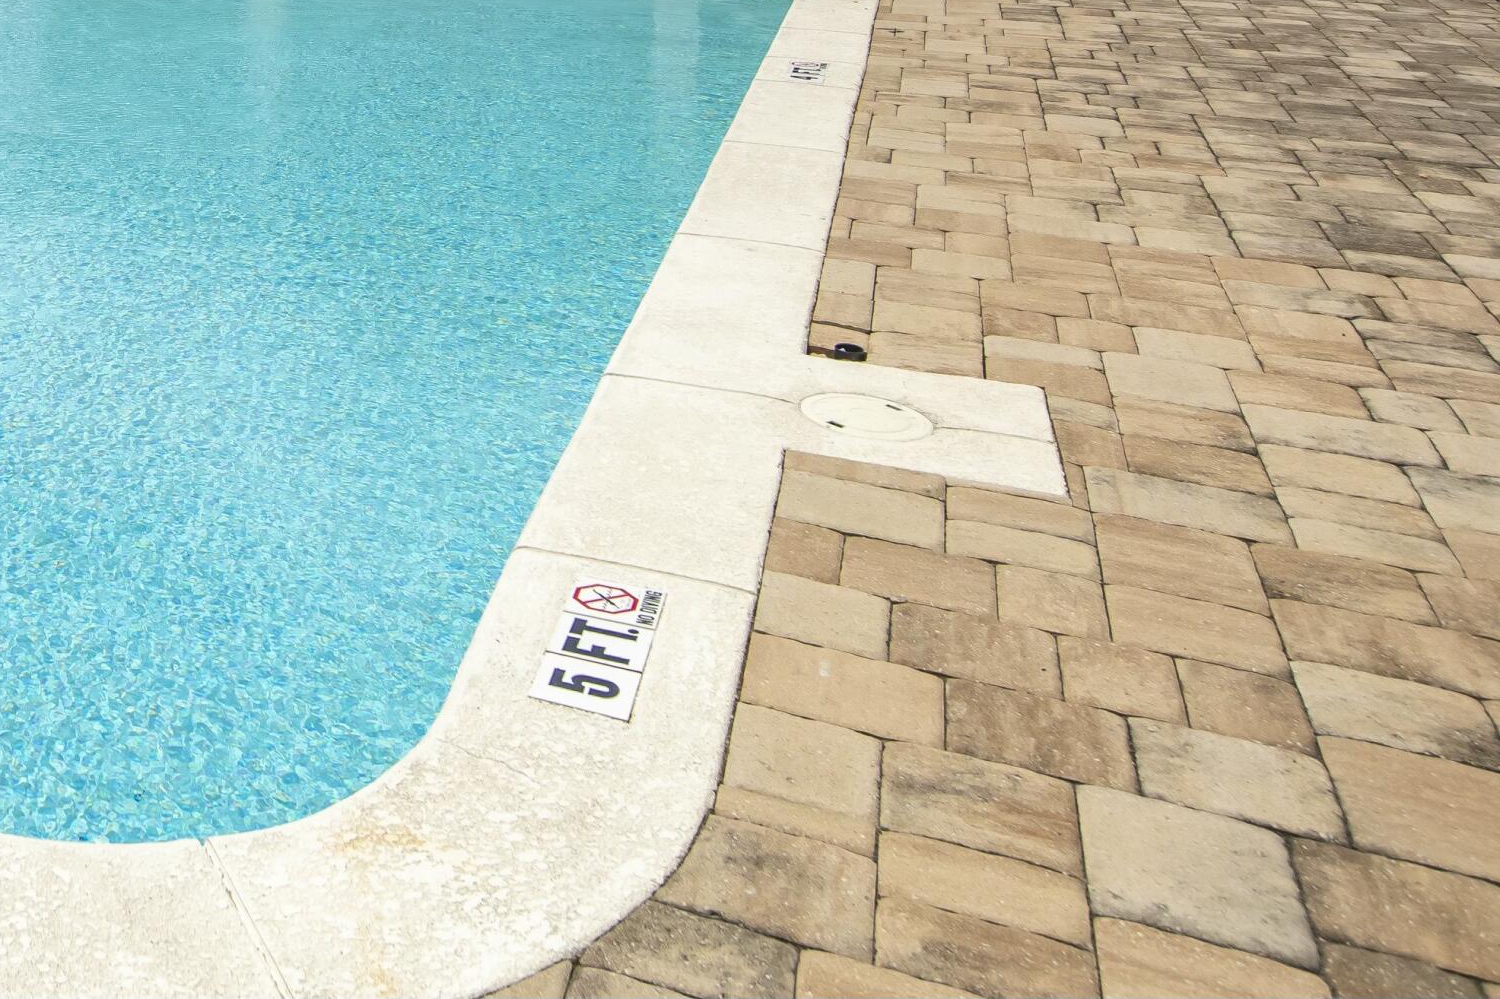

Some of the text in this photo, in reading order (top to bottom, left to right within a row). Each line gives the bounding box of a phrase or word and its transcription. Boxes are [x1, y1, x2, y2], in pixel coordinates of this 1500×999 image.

[636, 590, 663, 626] NO DIVING
[548, 667, 620, 699] 5
